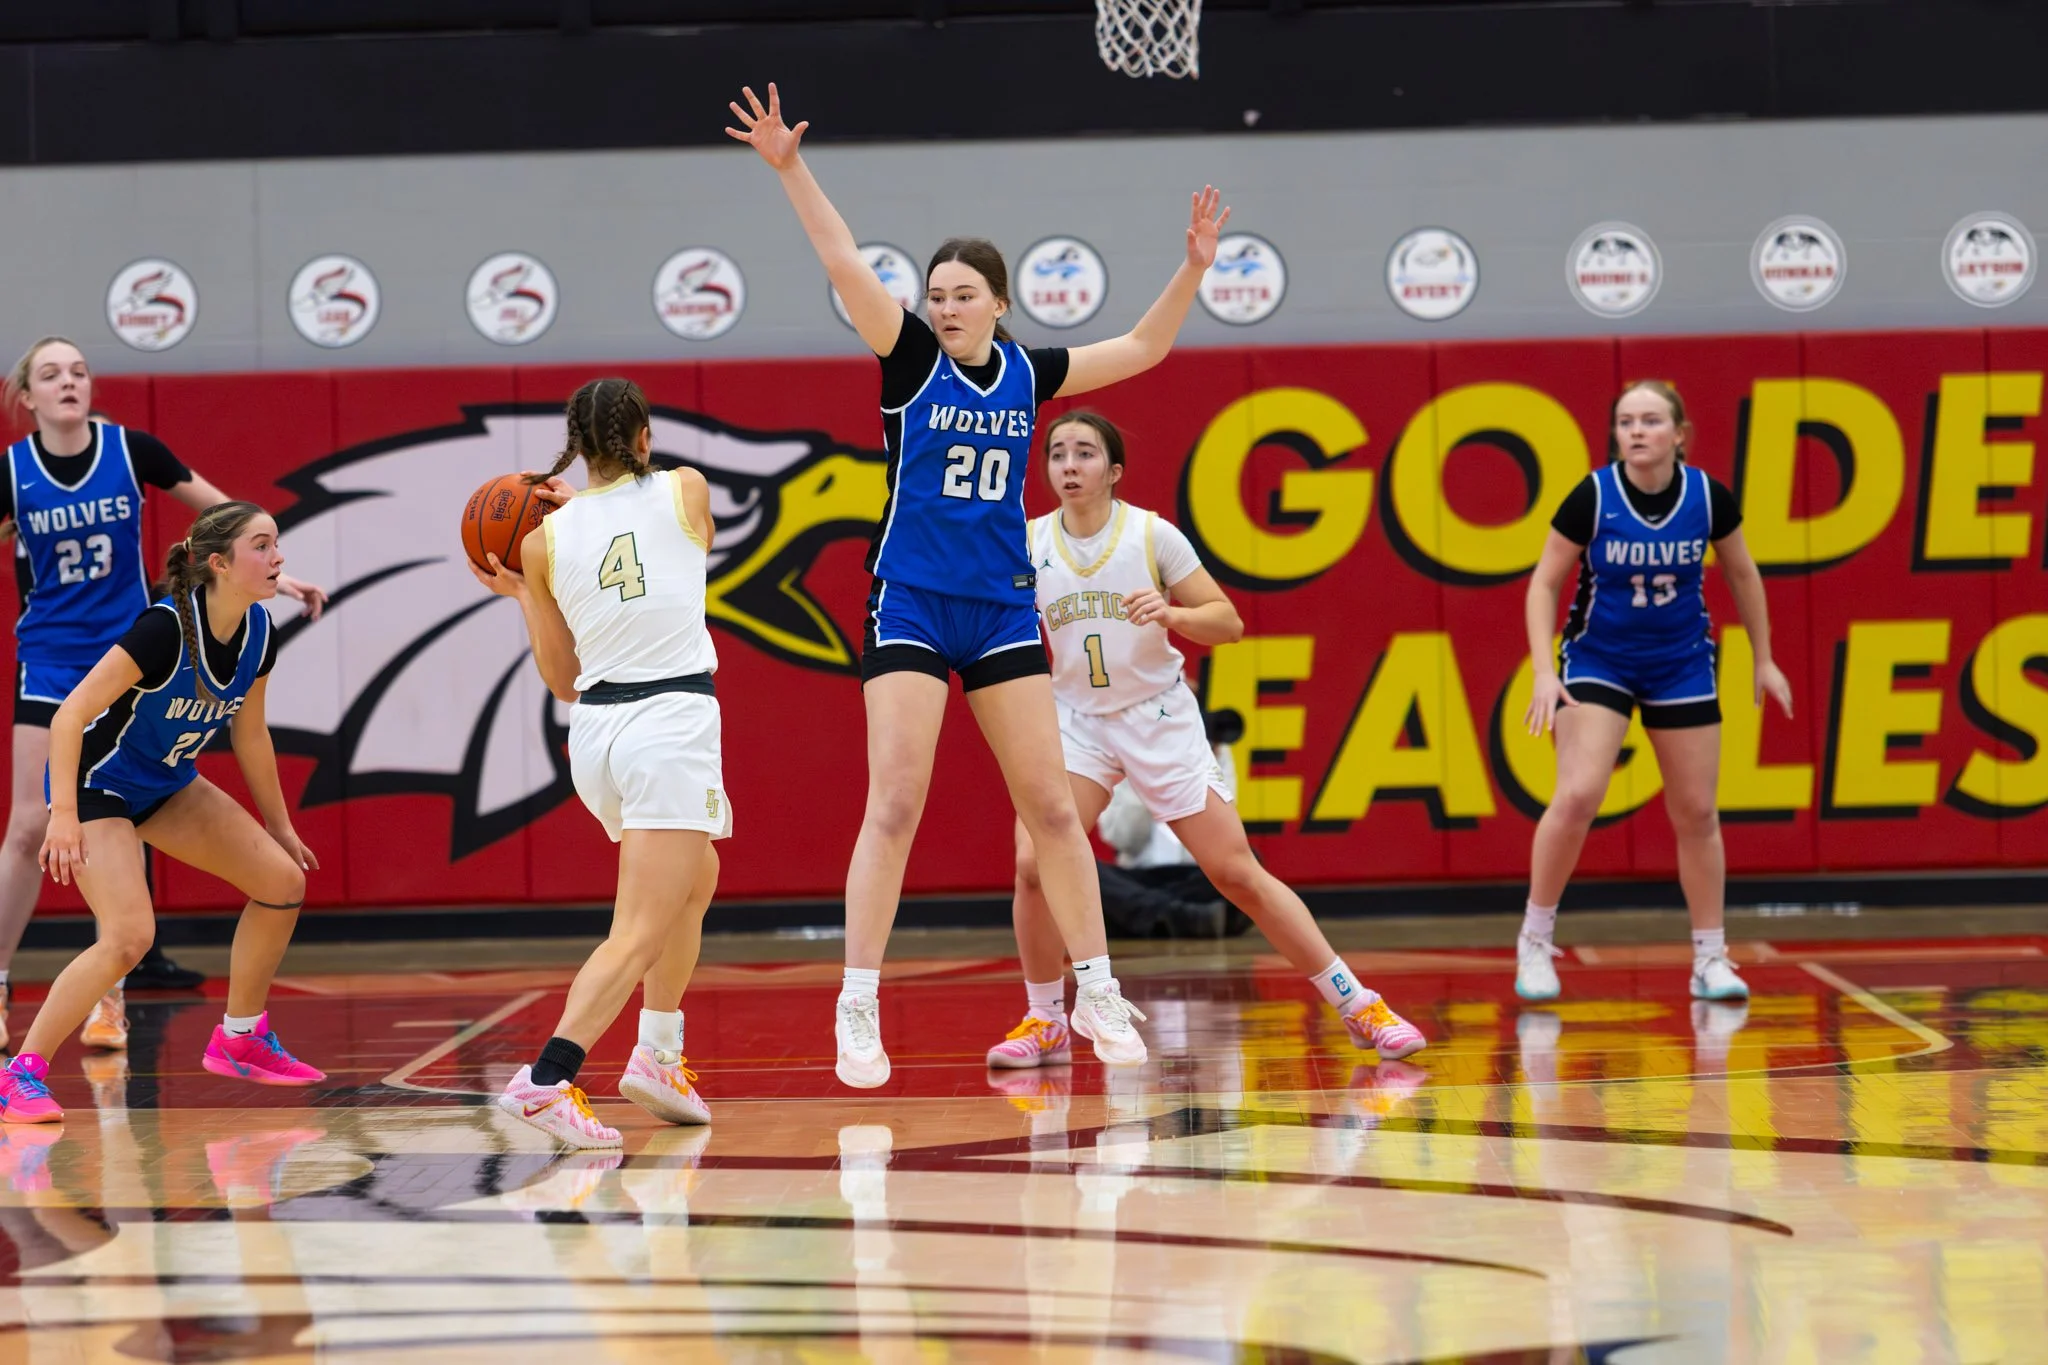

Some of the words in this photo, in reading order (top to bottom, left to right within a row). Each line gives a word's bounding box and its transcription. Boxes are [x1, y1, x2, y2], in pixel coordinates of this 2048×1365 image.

[928, 403, 1029, 437] WOLVES
[941, 444, 1011, 502] 20
[1188, 372, 2044, 581] GODE
[27, 495, 131, 535] WOLVES
[54, 533, 113, 584] 23
[598, 531, 646, 602] 4
[1605, 538, 1703, 566] WOLVES
[1046, 590, 1143, 632] CELTIC
[1083, 633, 1111, 688] 1
[164, 697, 246, 724] WOLVE
